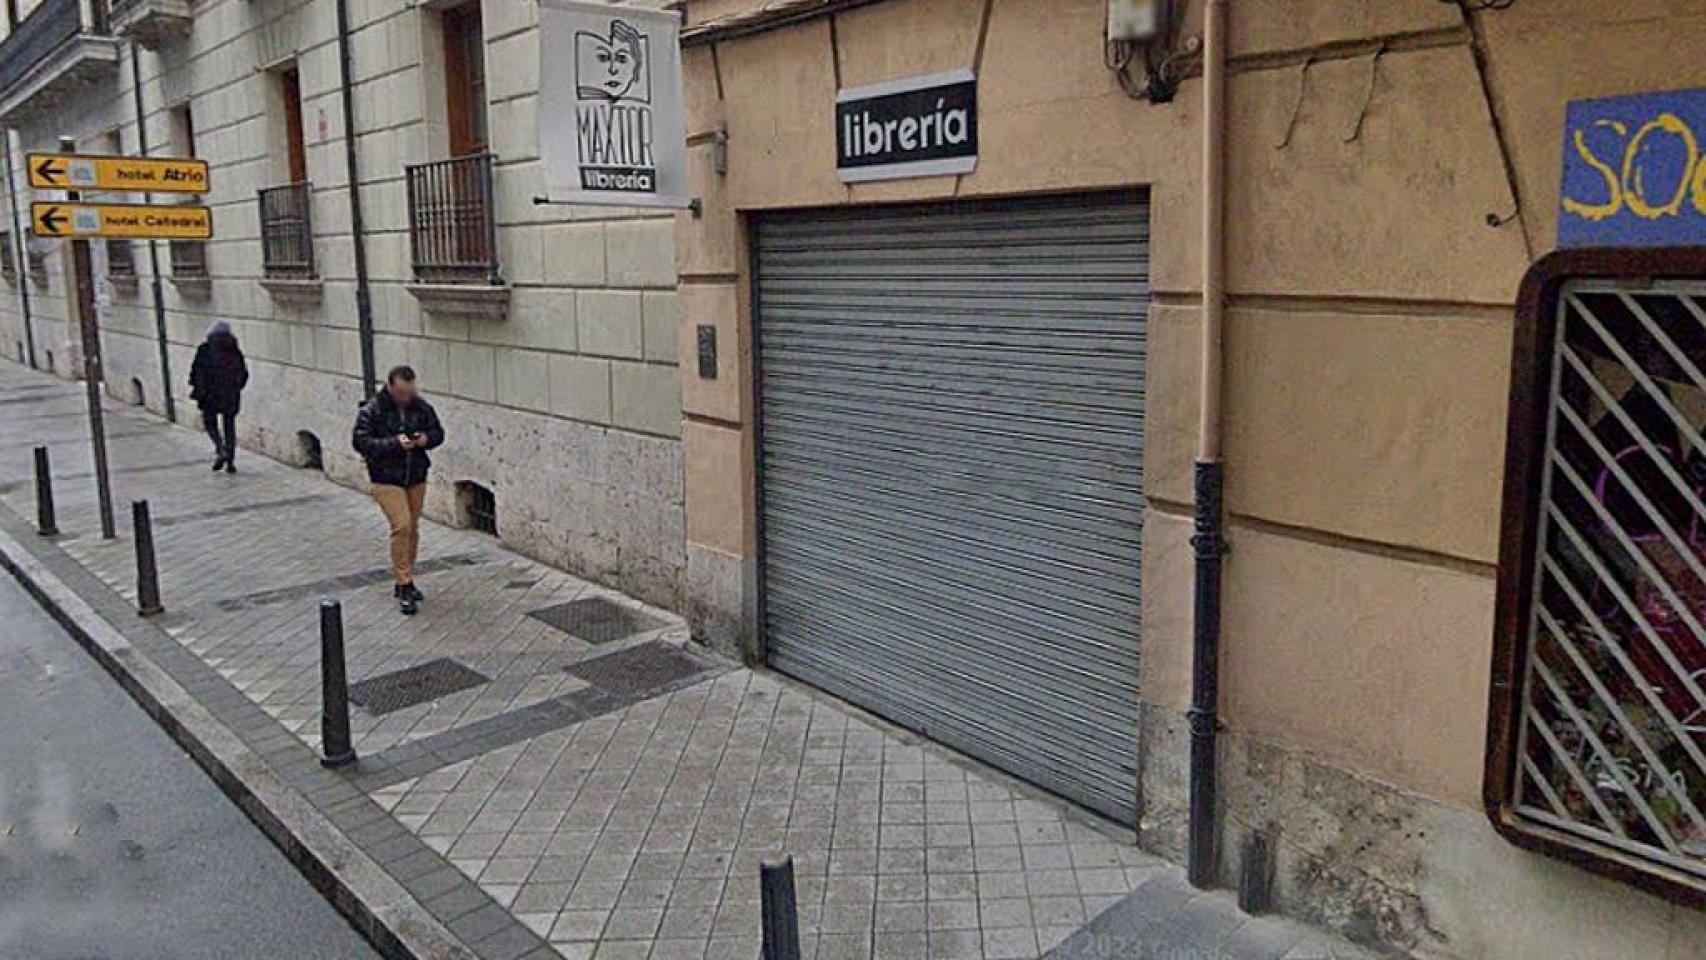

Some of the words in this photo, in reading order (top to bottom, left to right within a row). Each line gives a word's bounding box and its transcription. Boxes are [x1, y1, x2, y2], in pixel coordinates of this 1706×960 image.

[576, 104, 653, 166] MAXTOR
[843, 97, 969, 158] librería
[117, 168, 155, 181] hotel
[163, 167, 204, 182] Atrio
[105, 215, 140, 226] hotel
